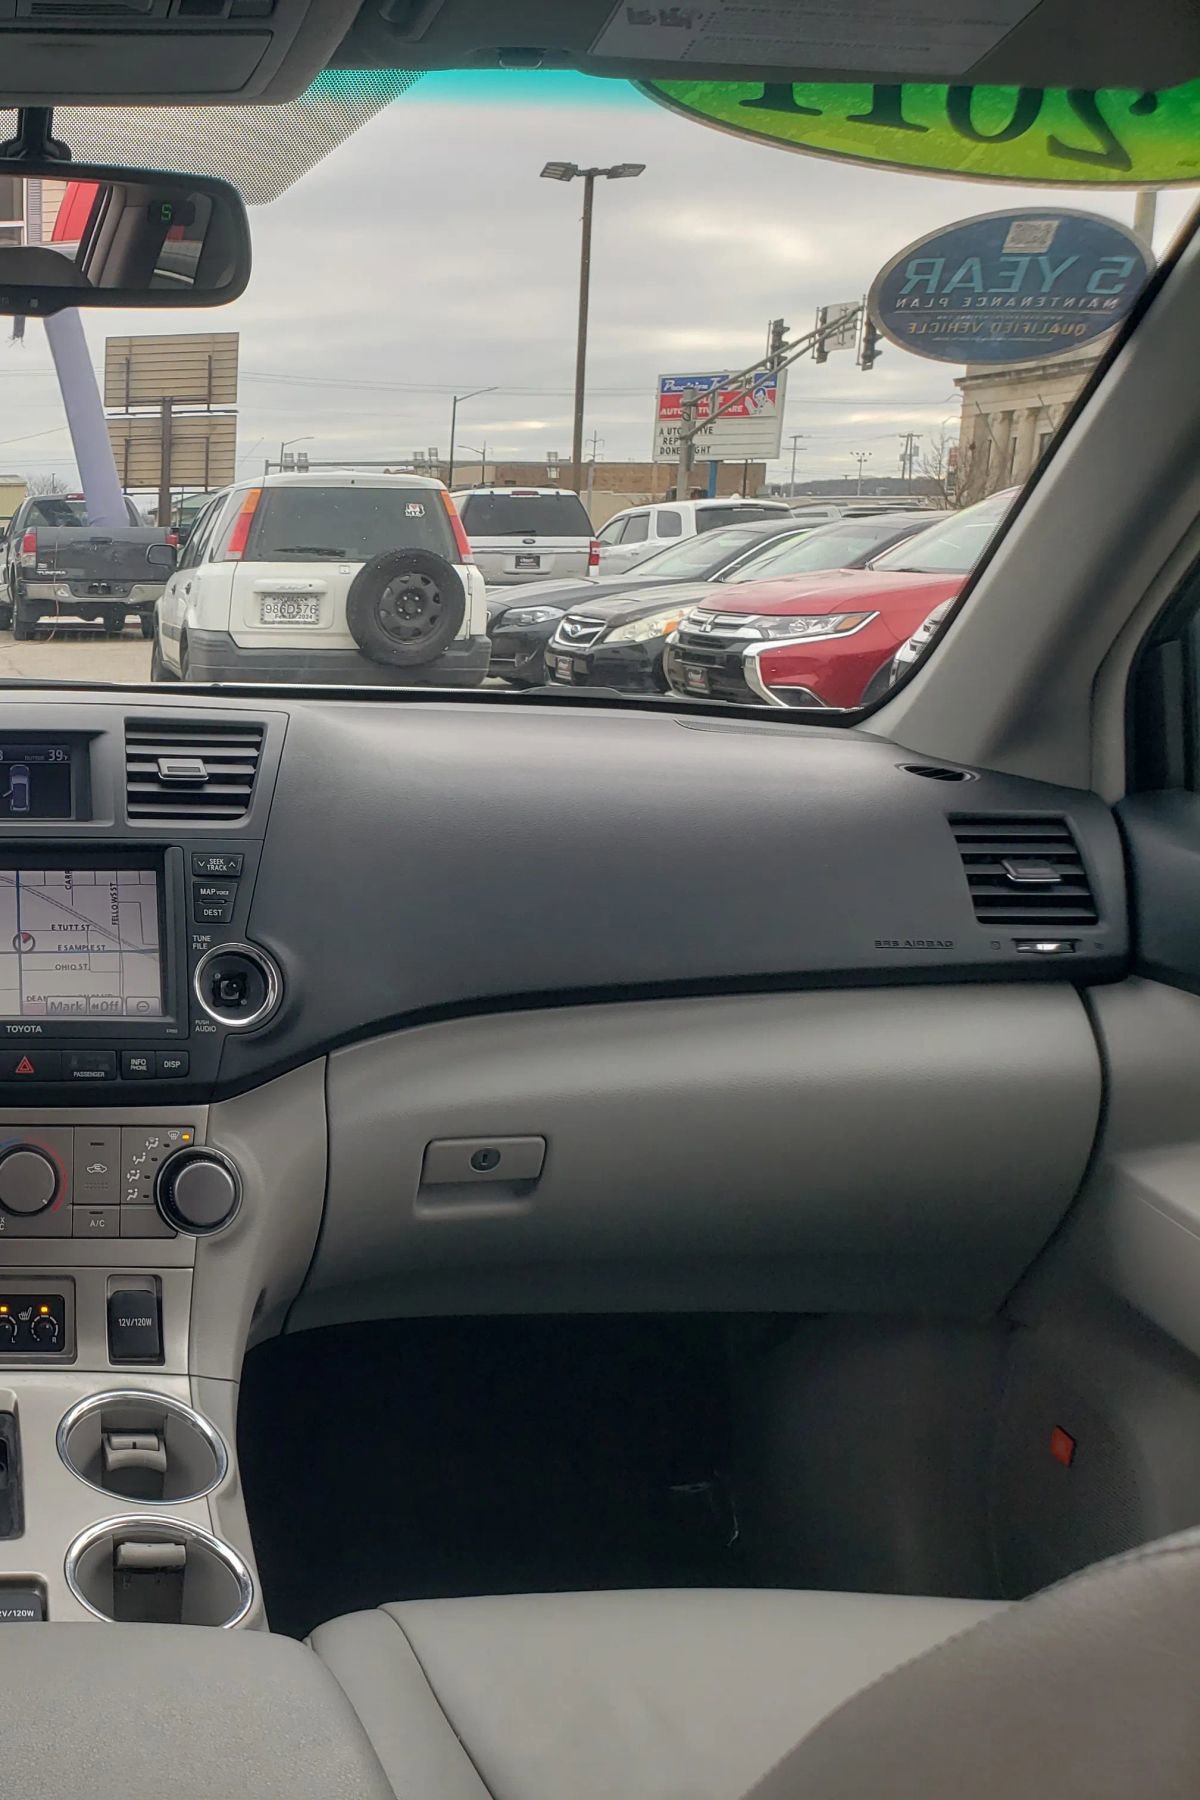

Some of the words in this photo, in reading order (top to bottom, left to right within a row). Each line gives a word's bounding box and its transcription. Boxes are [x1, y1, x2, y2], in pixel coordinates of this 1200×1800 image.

[206, 864, 227, 872] TRACK
[203, 909, 223, 917] DEST
[192, 942, 207, 950] FILE
[50, 1001, 83, 1012] Mark
[6, 1025, 43, 1033] TOYOTA
[195, 1025, 217, 1033] AUDIO
[130, 1057, 147, 1065] INFO
[163, 1060, 181, 1069] DISP
[73, 1070, 105, 1079] PASSENGER
[89, 1219, 105, 1228] A/C
[118, 1317, 152, 1327] 12V/120W
